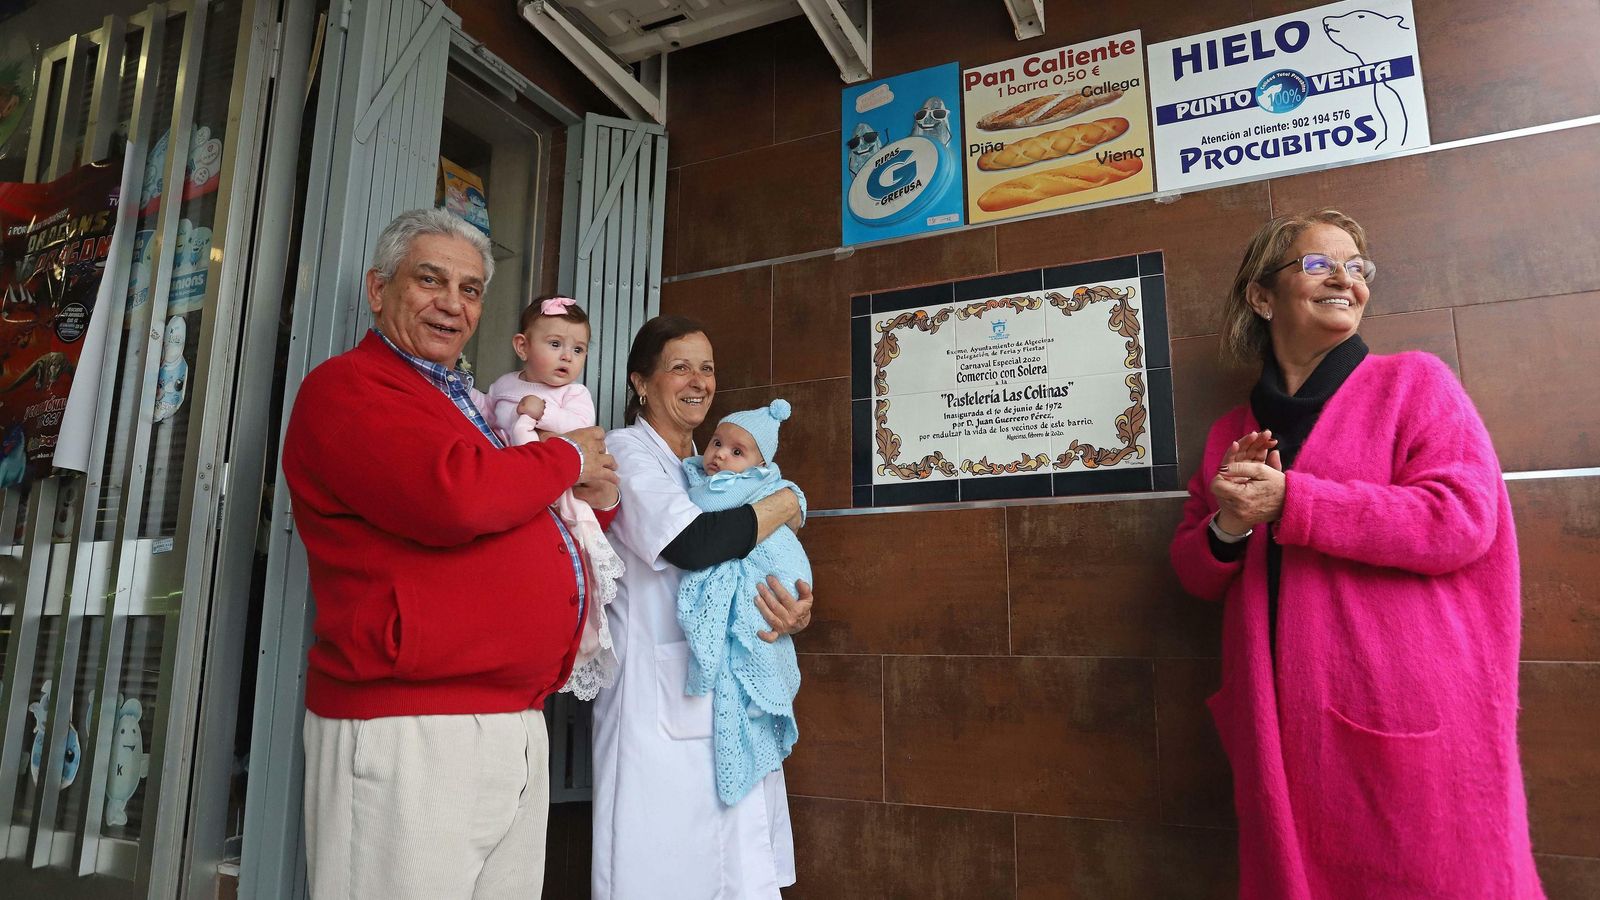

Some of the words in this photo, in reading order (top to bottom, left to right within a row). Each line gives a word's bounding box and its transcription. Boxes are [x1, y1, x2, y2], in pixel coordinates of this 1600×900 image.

[1171, 20, 1310, 82] HIELO
[964, 67, 1015, 92] Pan
[1023, 39, 1136, 78] Caliente
[997, 87, 1003, 98] 1
[1007, 79, 1048, 95] barra
[1052, 69, 1087, 86] 0,50
[1091, 65, 1101, 77] €
[1081, 77, 1140, 98] Gallega
[1176, 90, 1252, 119] PUNTO
[1312, 61, 1392, 93] VENTA
[1201, 130, 1241, 146] Atención
[1243, 128, 1251, 138] al
[1254, 122, 1290, 136] Cliente:
[1292, 117, 1310, 129] 902
[1313, 113, 1330, 125] 194
[1332, 109, 1351, 123] 576
[969, 140, 1005, 157] Piña
[1179, 114, 1377, 174] PROCUBITOS
[874, 147, 900, 168] PIPAS
[1095, 147, 1145, 165] Viena
[866, 149, 917, 200] G
[880, 179, 923, 206] GREFUSA
[956, 350, 990, 361] Delegación
[1000, 348, 1016, 356] Feria
[1022, 345, 1045, 353] Fiestas
[970, 342, 1015, 354] Ayuntamiento
[956, 368, 998, 383] Comercio
[1000, 368, 1016, 379] con
[1017, 363, 1047, 378] Solera
[960, 360, 991, 371] Carnaval
[993, 356, 1022, 368] Especial
[1002, 387, 1023, 403] Las
[943, 409, 984, 420] Inaugurada
[986, 407, 993, 415] el
[1003, 406, 1012, 414] de
[1012, 403, 1033, 416] junio
[1035, 402, 1043, 411] de
[1045, 402, 1063, 412] 1972
[919, 434, 930, 442] por
[932, 430, 962, 440] endulzar
[964, 428, 971, 436] la
[972, 426, 987, 435] vida
[989, 426, 997, 434] de
[999, 425, 1009, 433] los
[1011, 422, 1038, 432] vecinos
[1040, 421, 1048, 429] de
[1051, 420, 1065, 428] este
[952, 421, 965, 430] por
[966, 419, 974, 427] D.
[975, 418, 994, 429] Juan
[995, 415, 1029, 425] Guerrero
